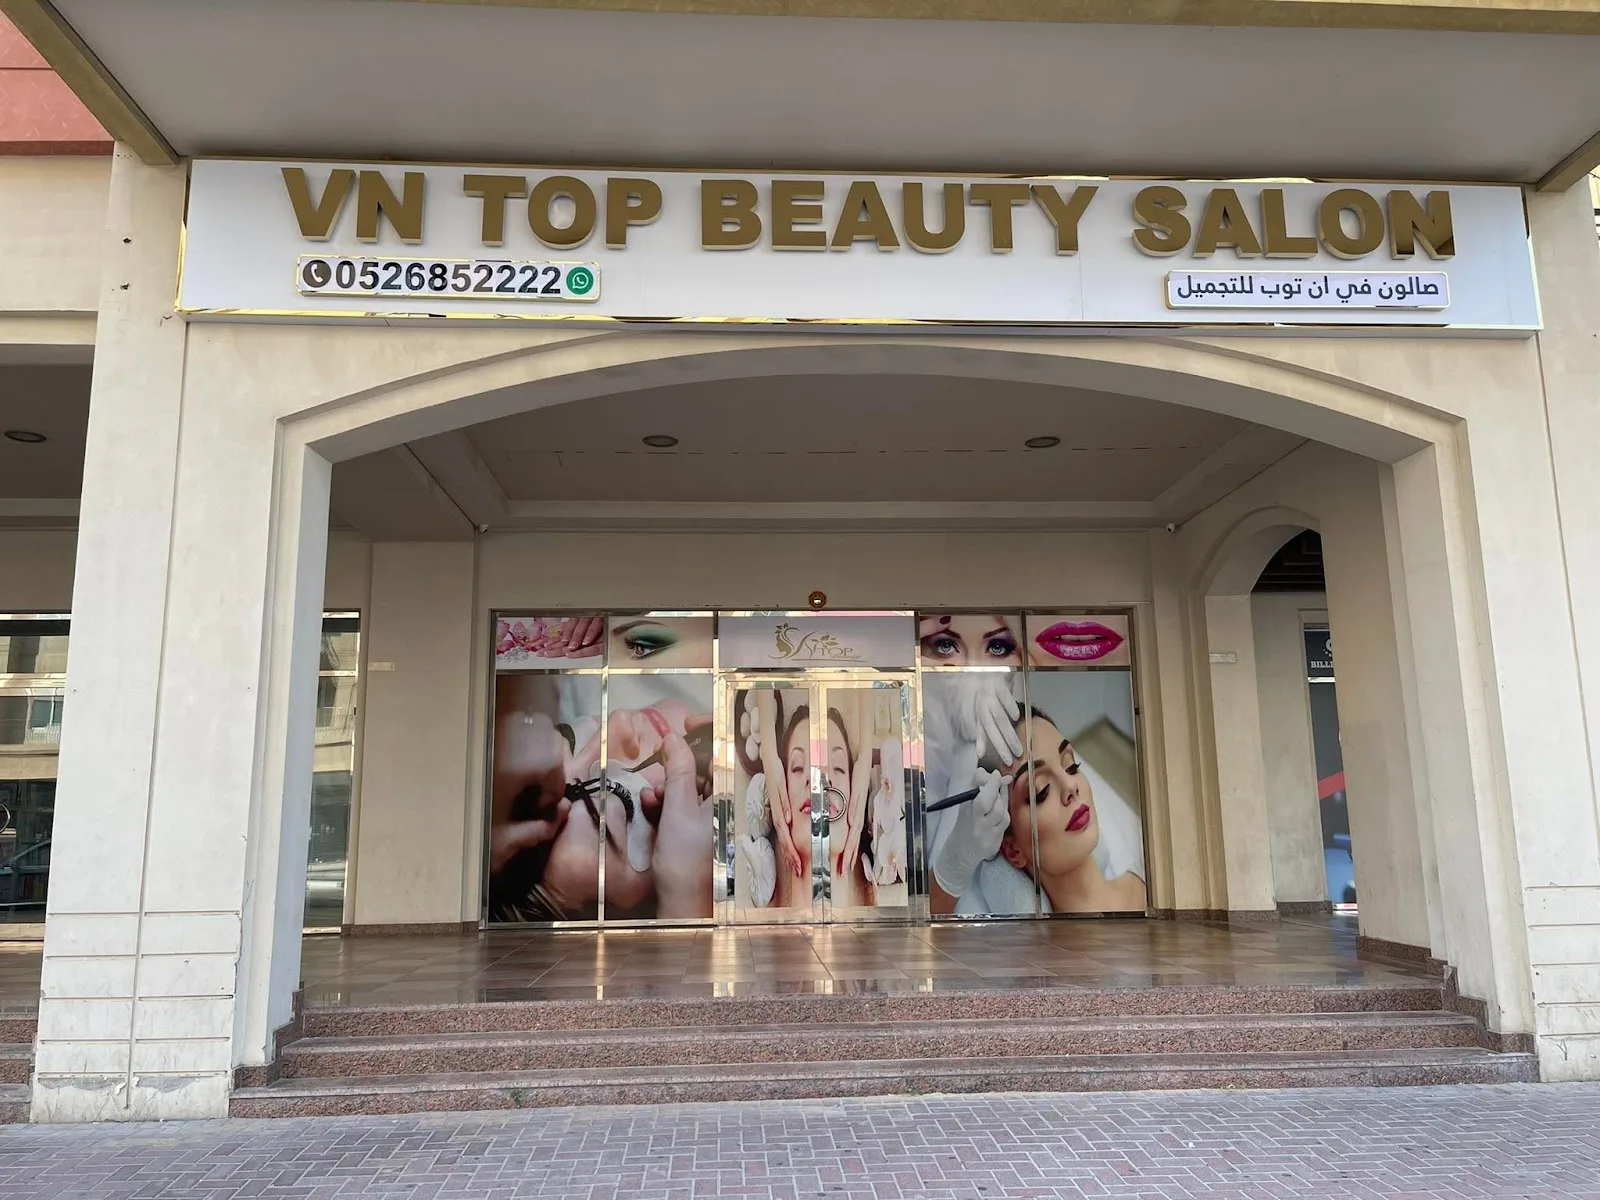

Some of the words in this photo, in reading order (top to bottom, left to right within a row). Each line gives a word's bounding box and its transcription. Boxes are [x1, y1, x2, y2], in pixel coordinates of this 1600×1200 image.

[281, 167, 426, 244] VN
[463, 174, 662, 249] TOP
[699, 178, 1099, 256] BEAUTY
[1133, 185, 1456, 260] SALON
[335, 261, 561, 297] 0526852222
[1178, 275, 1254, 298] للتجميل
[1261, 278, 1302, 299] توب
[1308, 275, 1329, 299] ان
[1336, 278, 1372, 303] في
[1378, 276, 1439, 300] صالون
